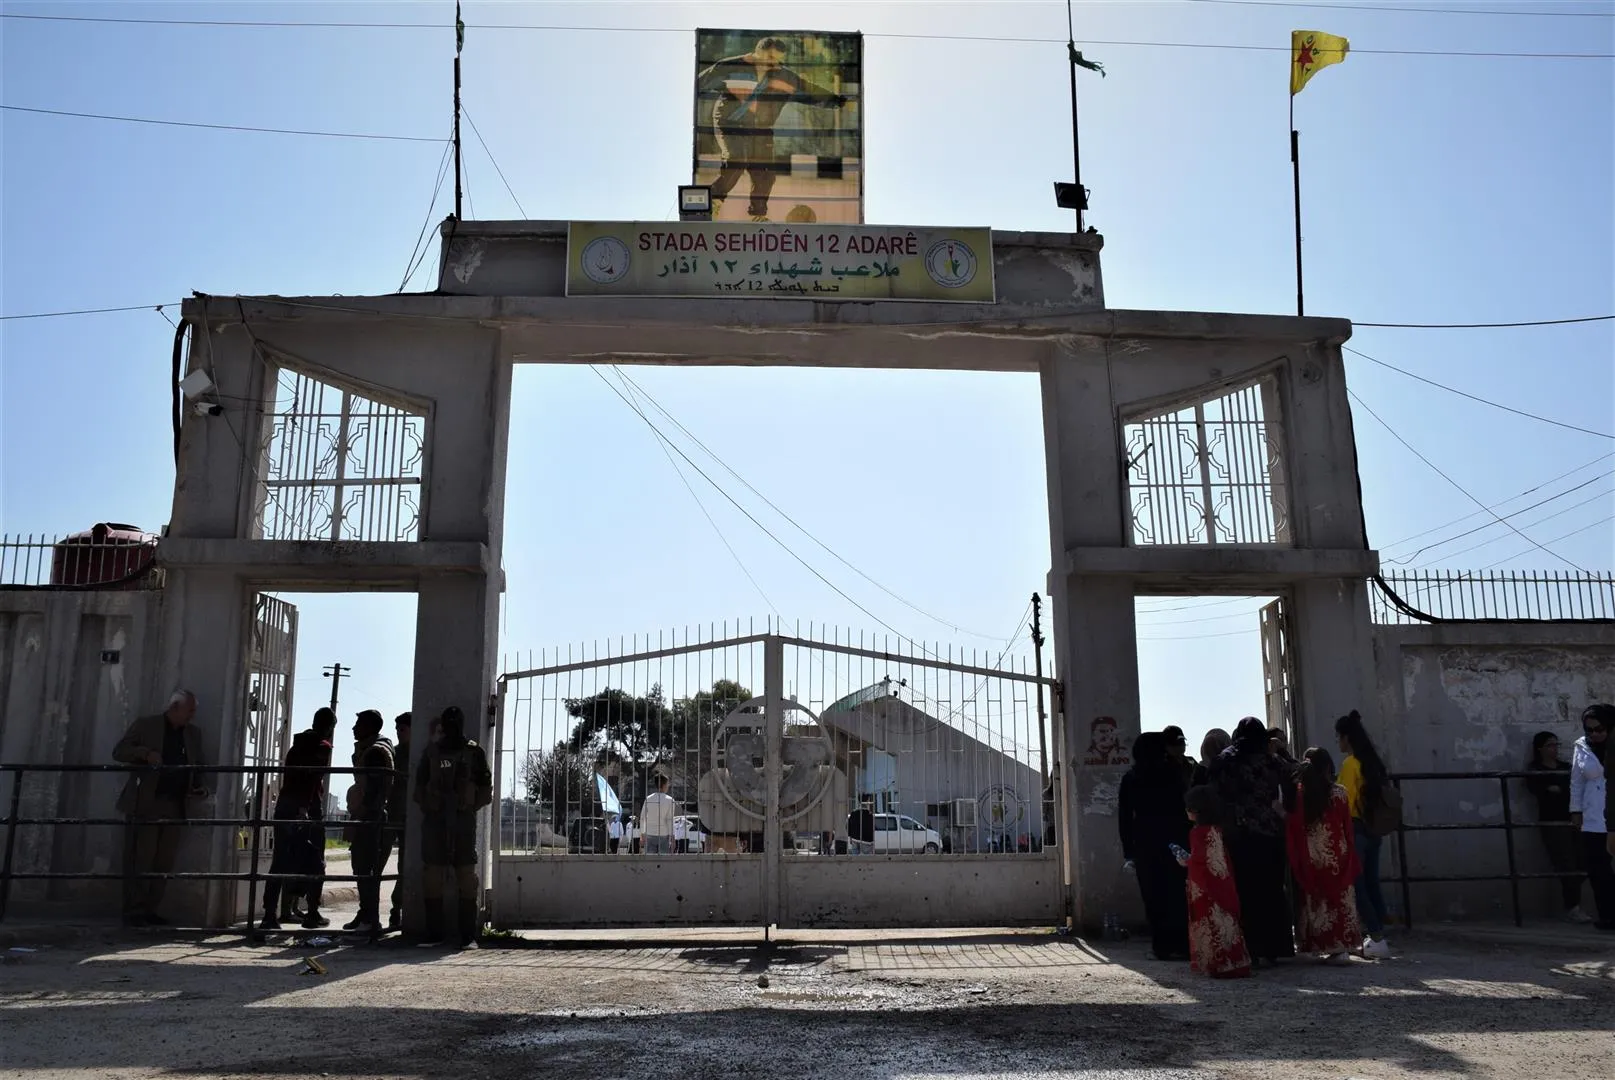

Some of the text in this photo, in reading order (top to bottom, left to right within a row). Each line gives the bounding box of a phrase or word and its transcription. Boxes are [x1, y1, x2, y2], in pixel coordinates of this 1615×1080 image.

[639, 229, 917, 255] STADA ŞEHÎDÊN 12 ADARÊ
[657, 256, 900, 280] ملاعب شهداء ١٢ آذار
[748, 280, 763, 291] 12
